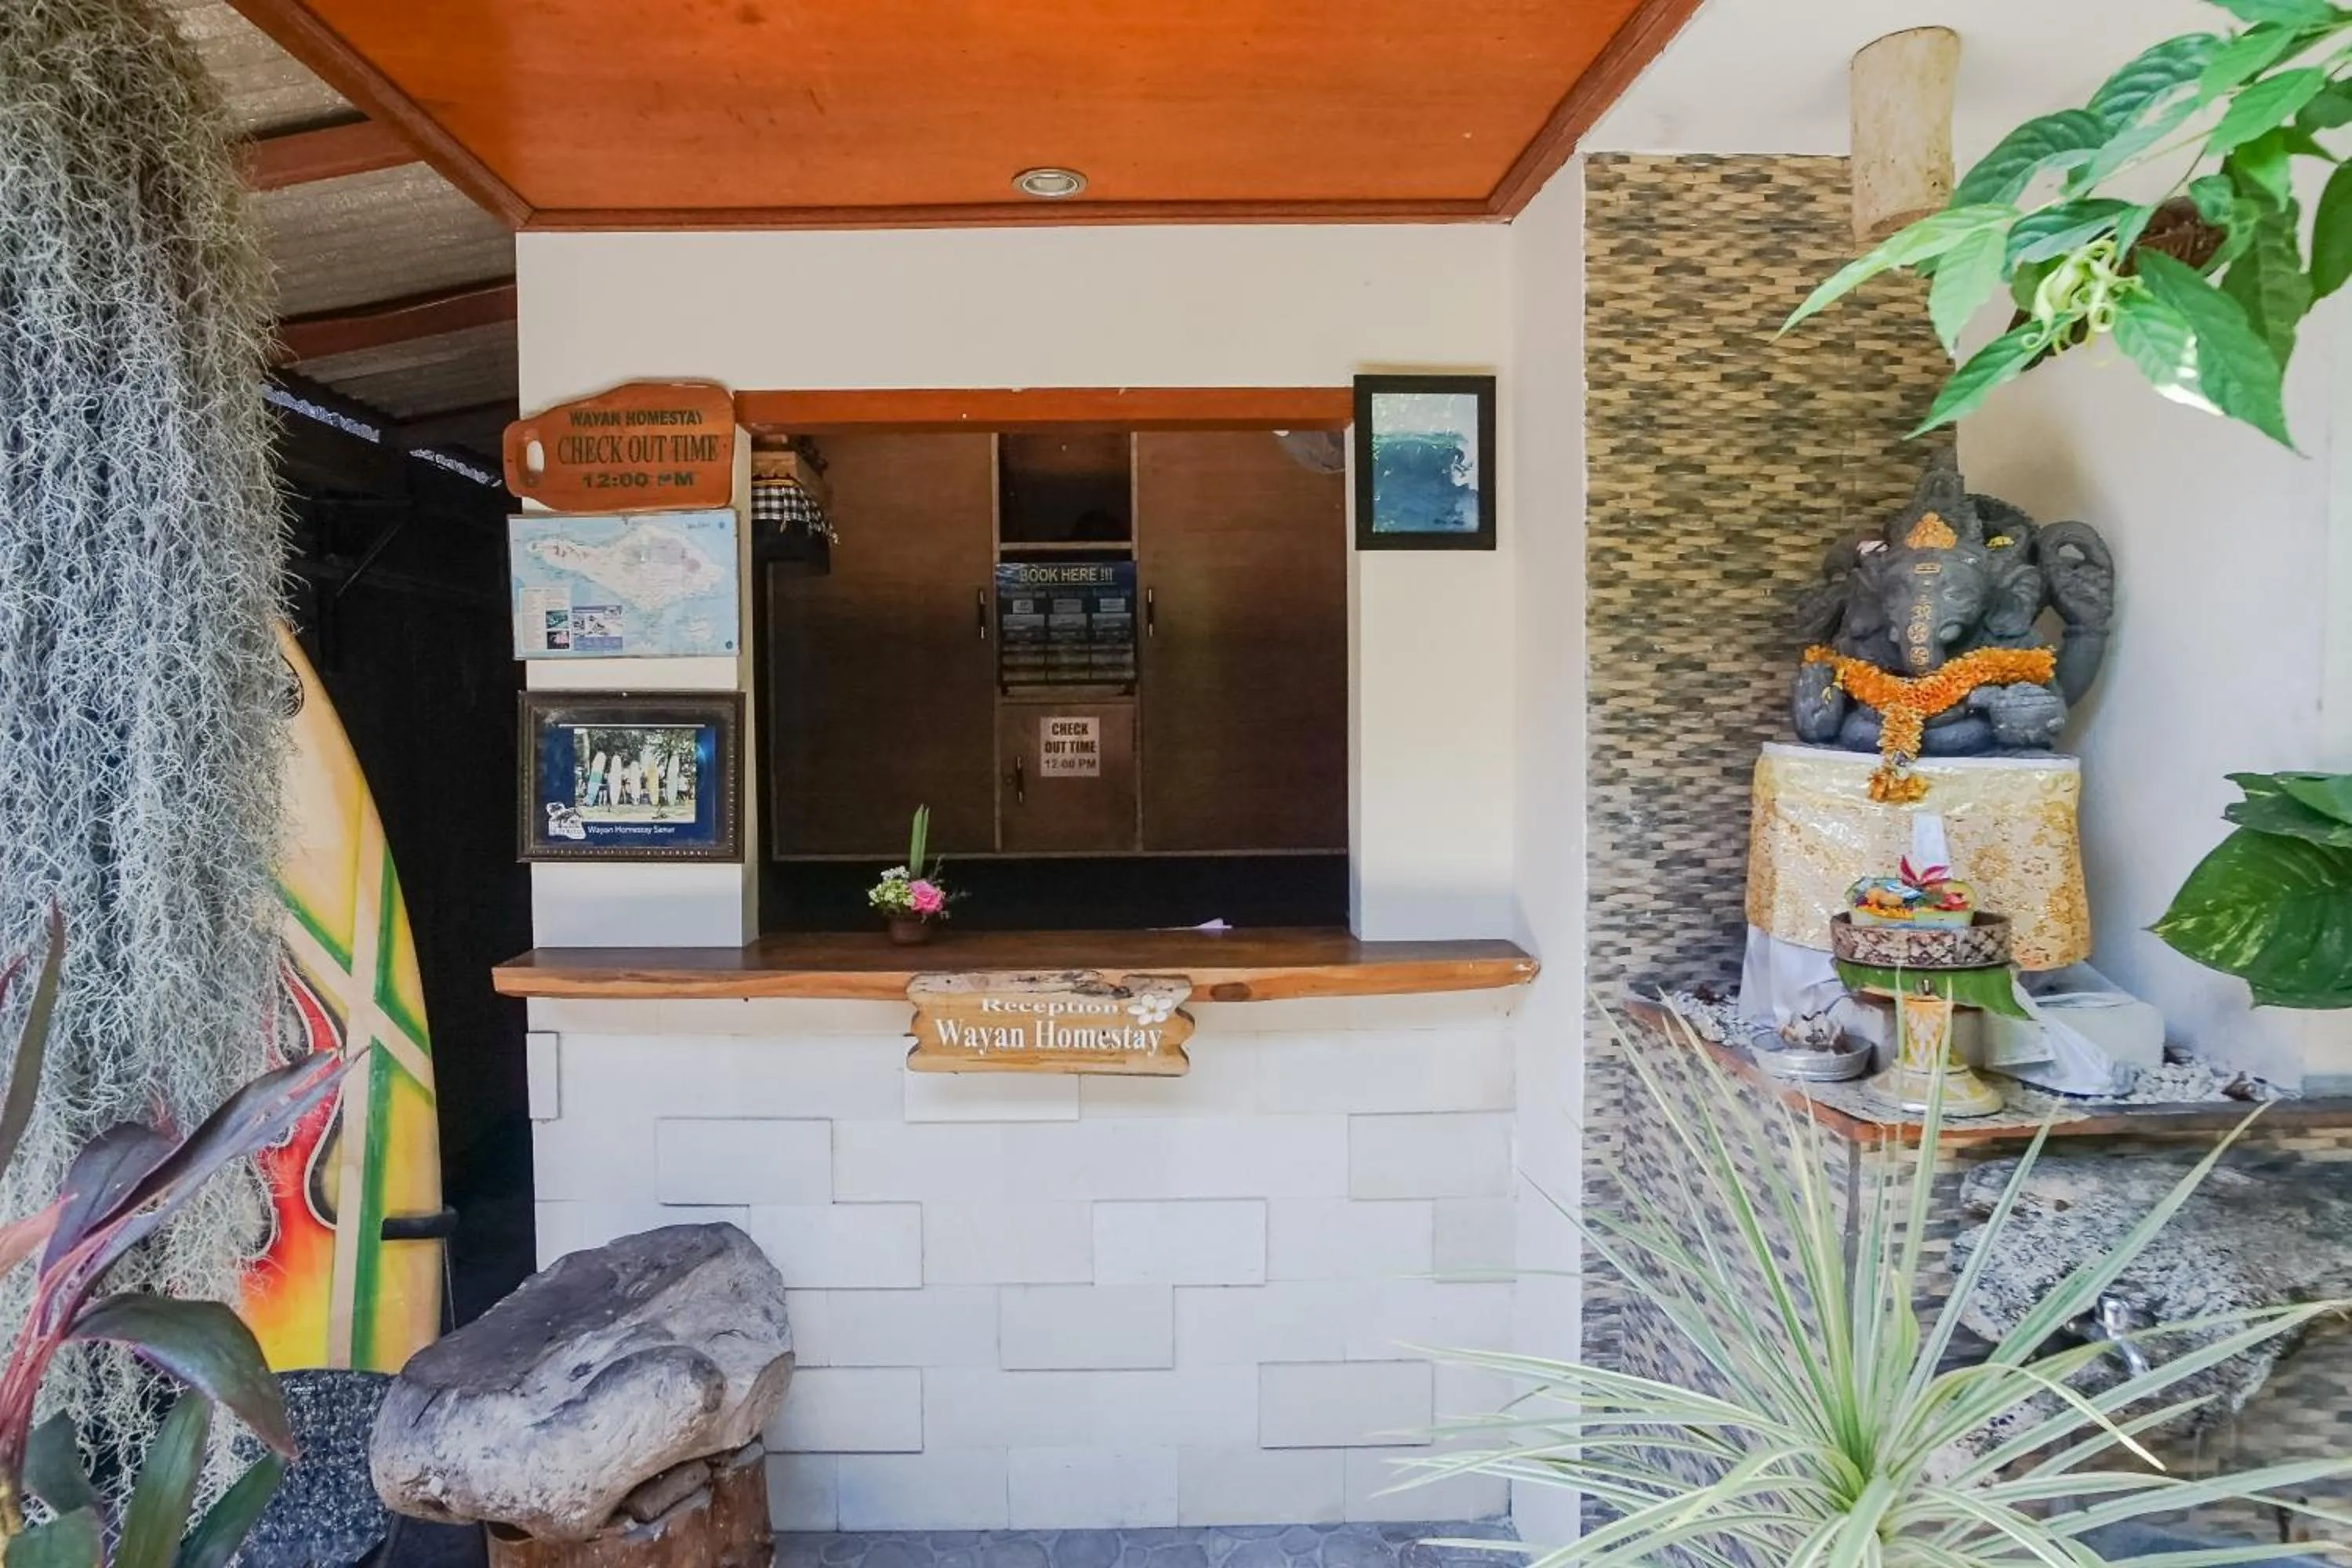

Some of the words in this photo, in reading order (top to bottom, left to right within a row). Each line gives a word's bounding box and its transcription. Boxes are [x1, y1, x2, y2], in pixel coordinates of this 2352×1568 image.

[570, 410, 621, 427] WAYAN
[557, 435, 622, 465] CHECK
[628, 435, 666, 463] OUT
[670, 434, 719, 462] TIME
[582, 472, 648, 488] 12:00
[657, 471, 694, 487] PM
[1020, 568, 1058, 582] BOOK
[1061, 568, 1097, 582] HERE
[1051, 722, 1089, 736] CHECK
[1044, 741, 1066, 753] OUT
[1069, 741, 1096, 753] TIME
[1044, 758, 1075, 769] 1200
[1078, 759, 1096, 768] PM
[981, 998, 1119, 1016] Reception
[935, 1018, 1025, 1054] Wayan
[1034, 1019, 1163, 1057] Homestay
